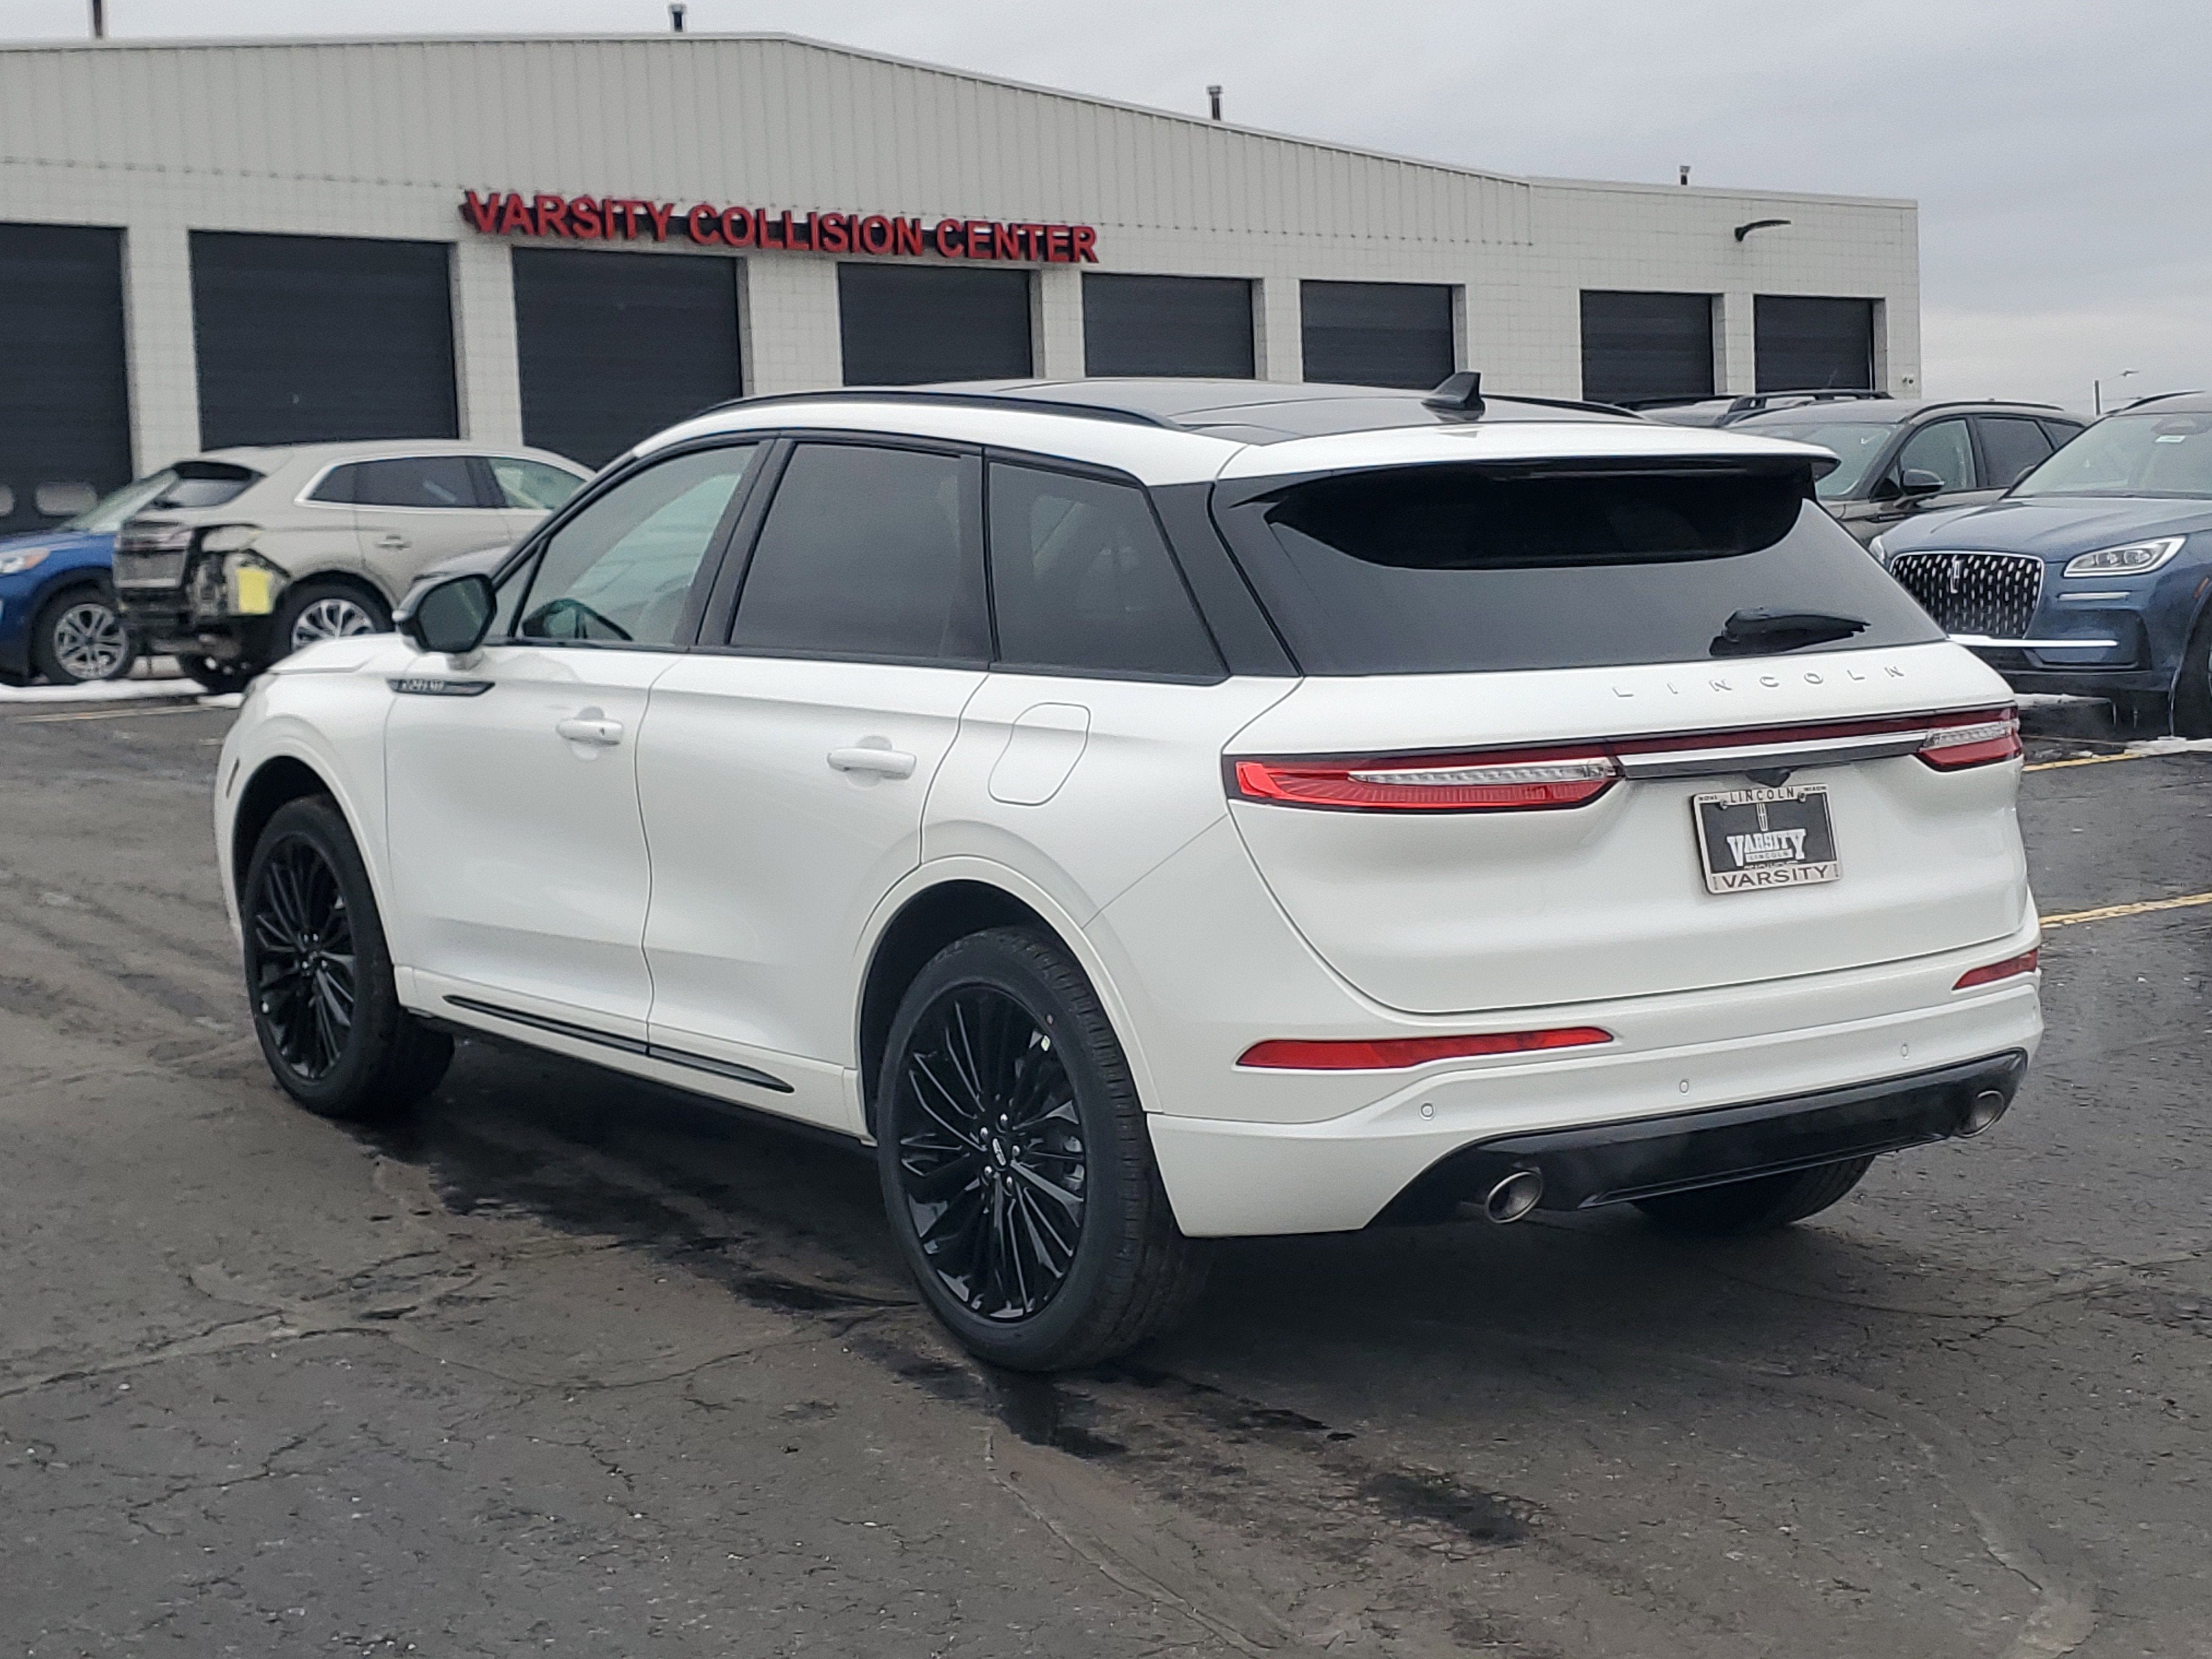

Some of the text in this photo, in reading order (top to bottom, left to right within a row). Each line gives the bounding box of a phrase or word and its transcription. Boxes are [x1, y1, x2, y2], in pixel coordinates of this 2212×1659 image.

[466, 190, 1098, 262] VARSITY COLLISION CENTER
[1612, 665, 1905, 698] LINCOLN
[1730, 787, 1793, 803] LINCOLN
[1726, 828, 1806, 867] VARSITY
[1722, 865, 1827, 888] VARSITY
